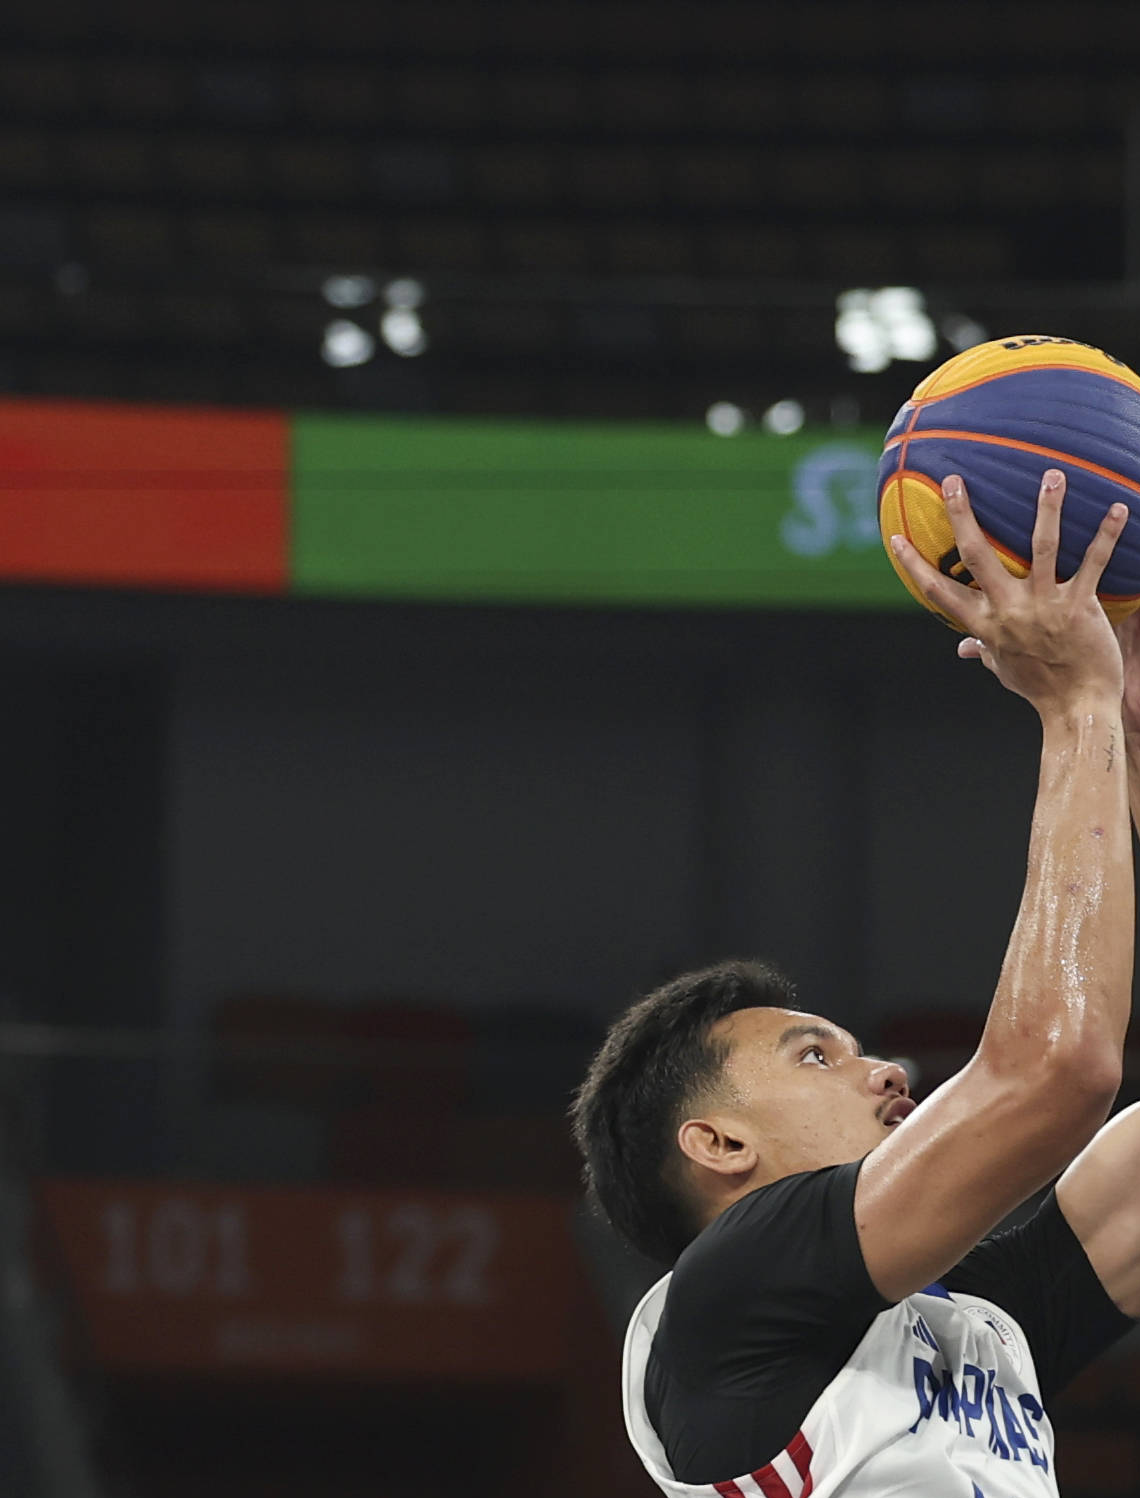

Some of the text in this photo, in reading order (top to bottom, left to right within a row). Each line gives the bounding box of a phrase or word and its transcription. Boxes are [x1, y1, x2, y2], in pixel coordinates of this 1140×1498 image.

[101, 1201, 499, 1301] 101 122
[909, 1357, 1049, 1475] PPNAS
